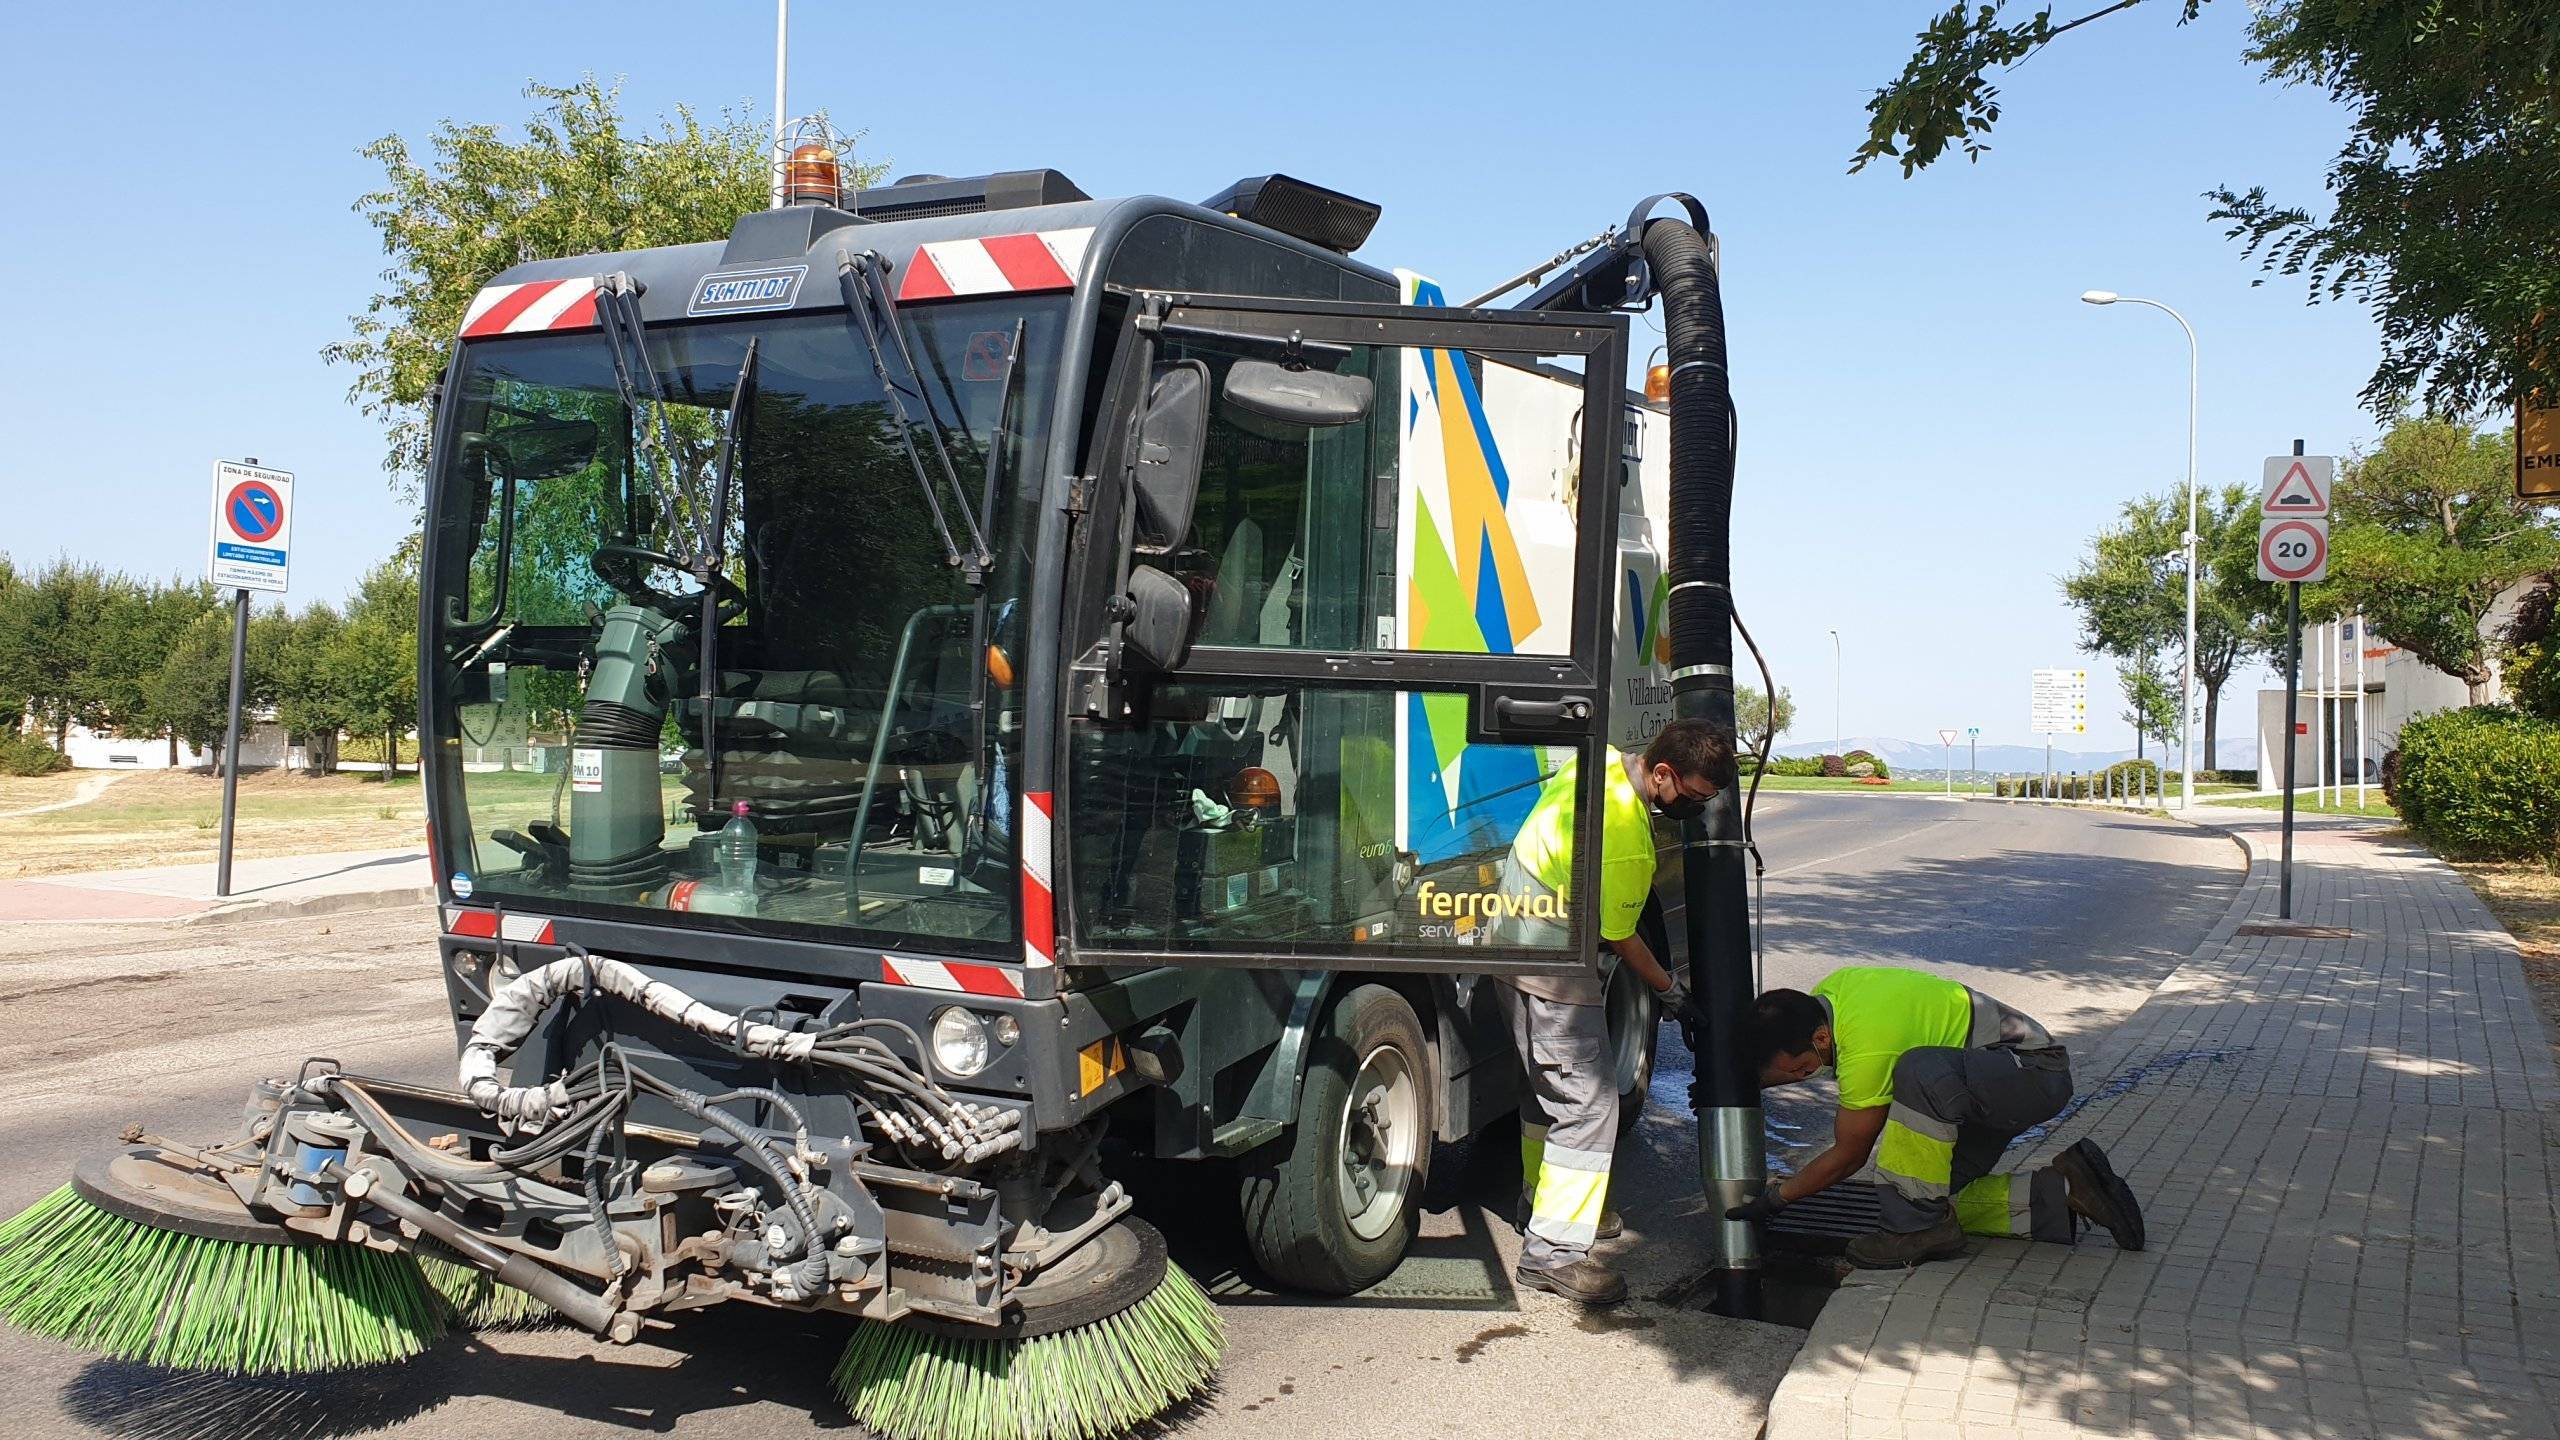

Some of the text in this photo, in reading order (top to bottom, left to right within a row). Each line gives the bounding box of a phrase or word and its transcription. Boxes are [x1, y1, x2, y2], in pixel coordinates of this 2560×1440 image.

[701, 276, 793, 303] SCHMIDT
[223, 466, 242, 475] ZONA
[254, 471, 290, 483] SEGURIDAD
[2278, 542, 2307, 557] 20
[1627, 678, 1673, 706] Villanuev
[586, 766, 600, 776] 10
[1359, 839, 1392, 858] euro6
[1417, 881, 1568, 919] ferrovial
